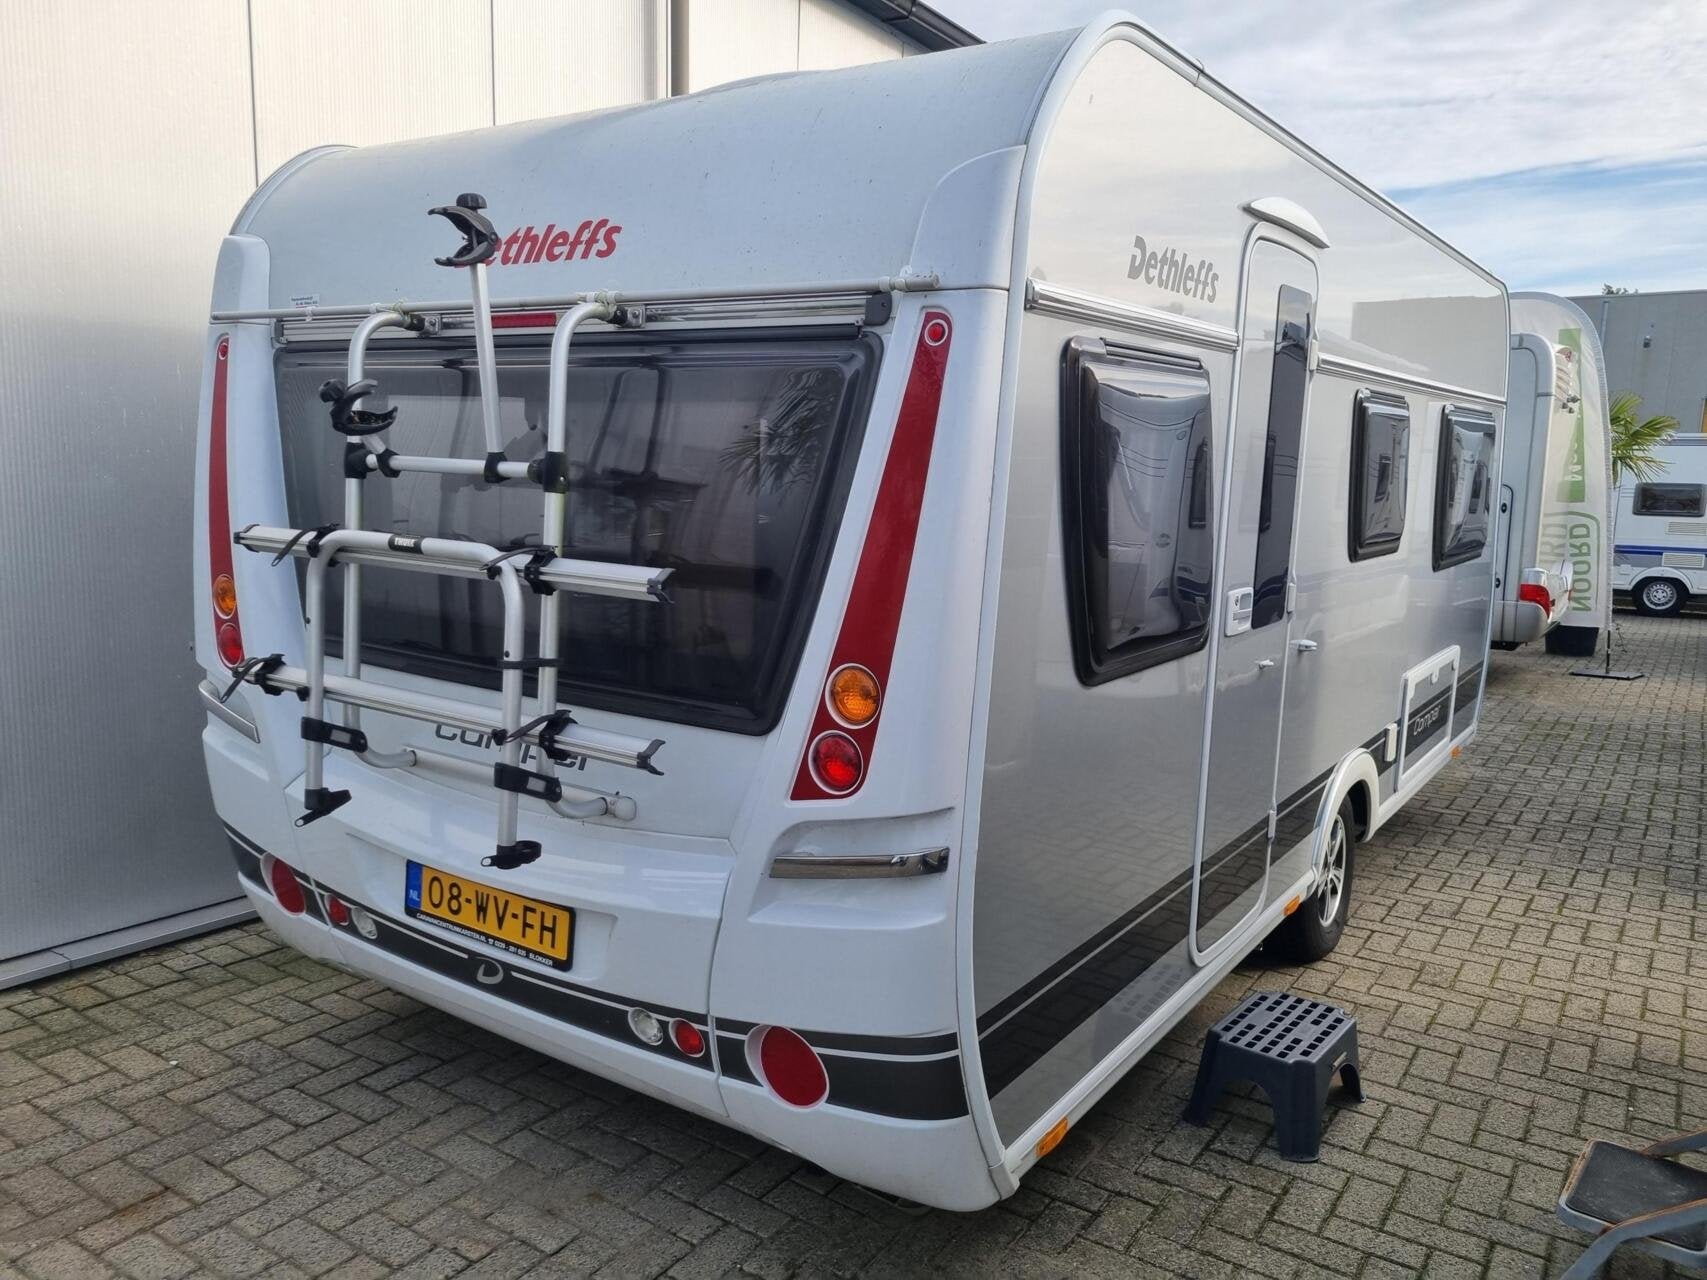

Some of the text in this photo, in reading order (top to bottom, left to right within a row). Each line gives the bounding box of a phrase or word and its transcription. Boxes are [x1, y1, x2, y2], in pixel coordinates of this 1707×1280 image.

[455, 219, 622, 268] thleffs
[1127, 234, 1219, 304] Dethleffs
[409, 889, 420, 901] NL
[428, 876, 557, 949] 08-WV-FH
